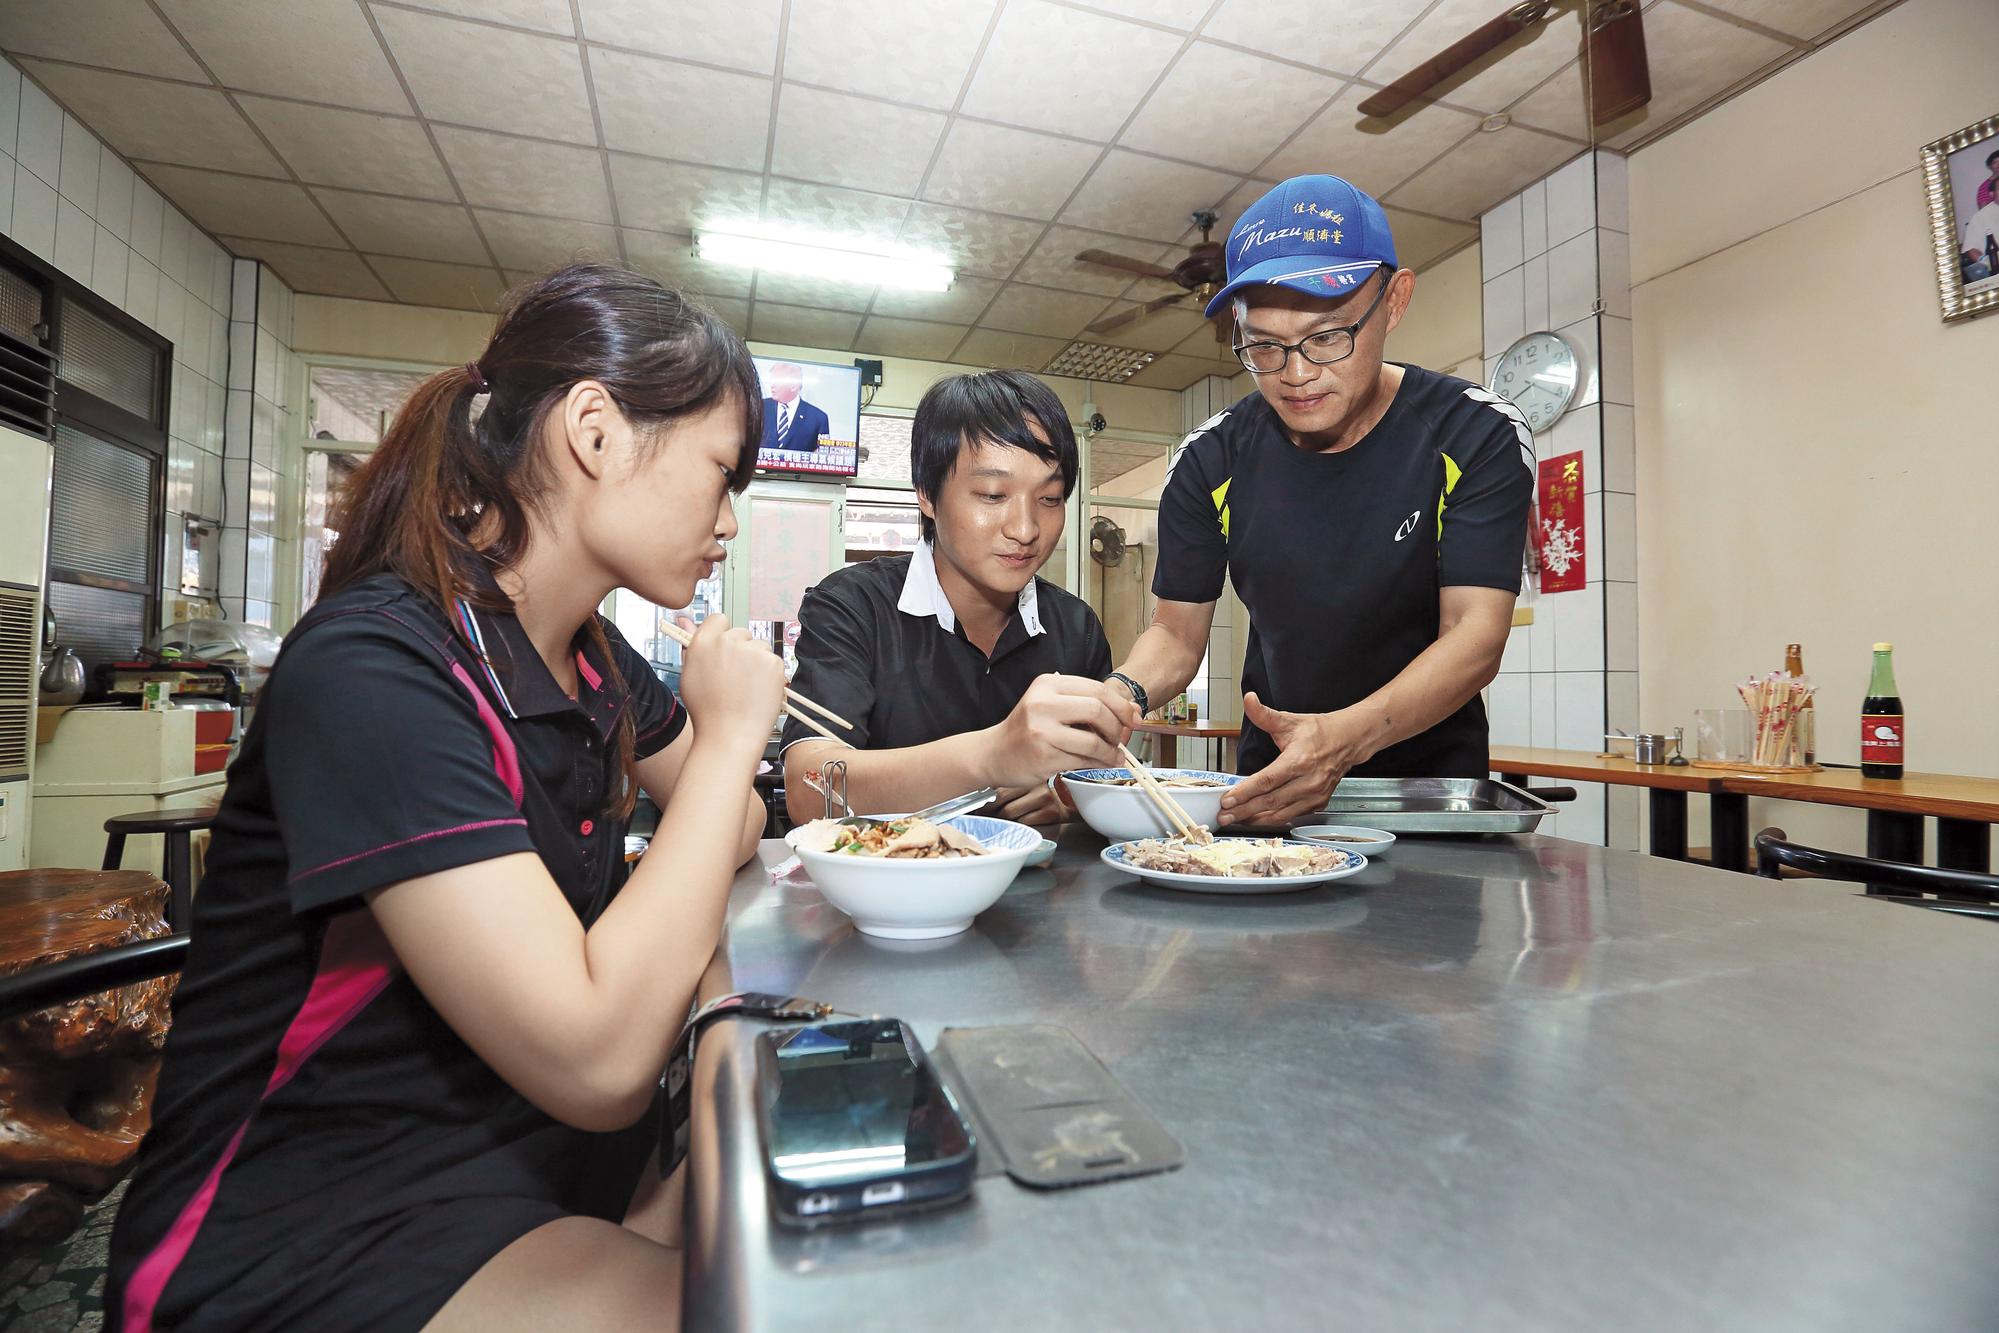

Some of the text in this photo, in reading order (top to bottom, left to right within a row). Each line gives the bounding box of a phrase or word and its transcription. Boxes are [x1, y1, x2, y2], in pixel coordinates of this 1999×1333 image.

[1293, 202, 1344, 226] 佳冬媽祖
[1237, 227, 1302, 261] Mazu
[1301, 228, 1345, 245] 順濟堂
